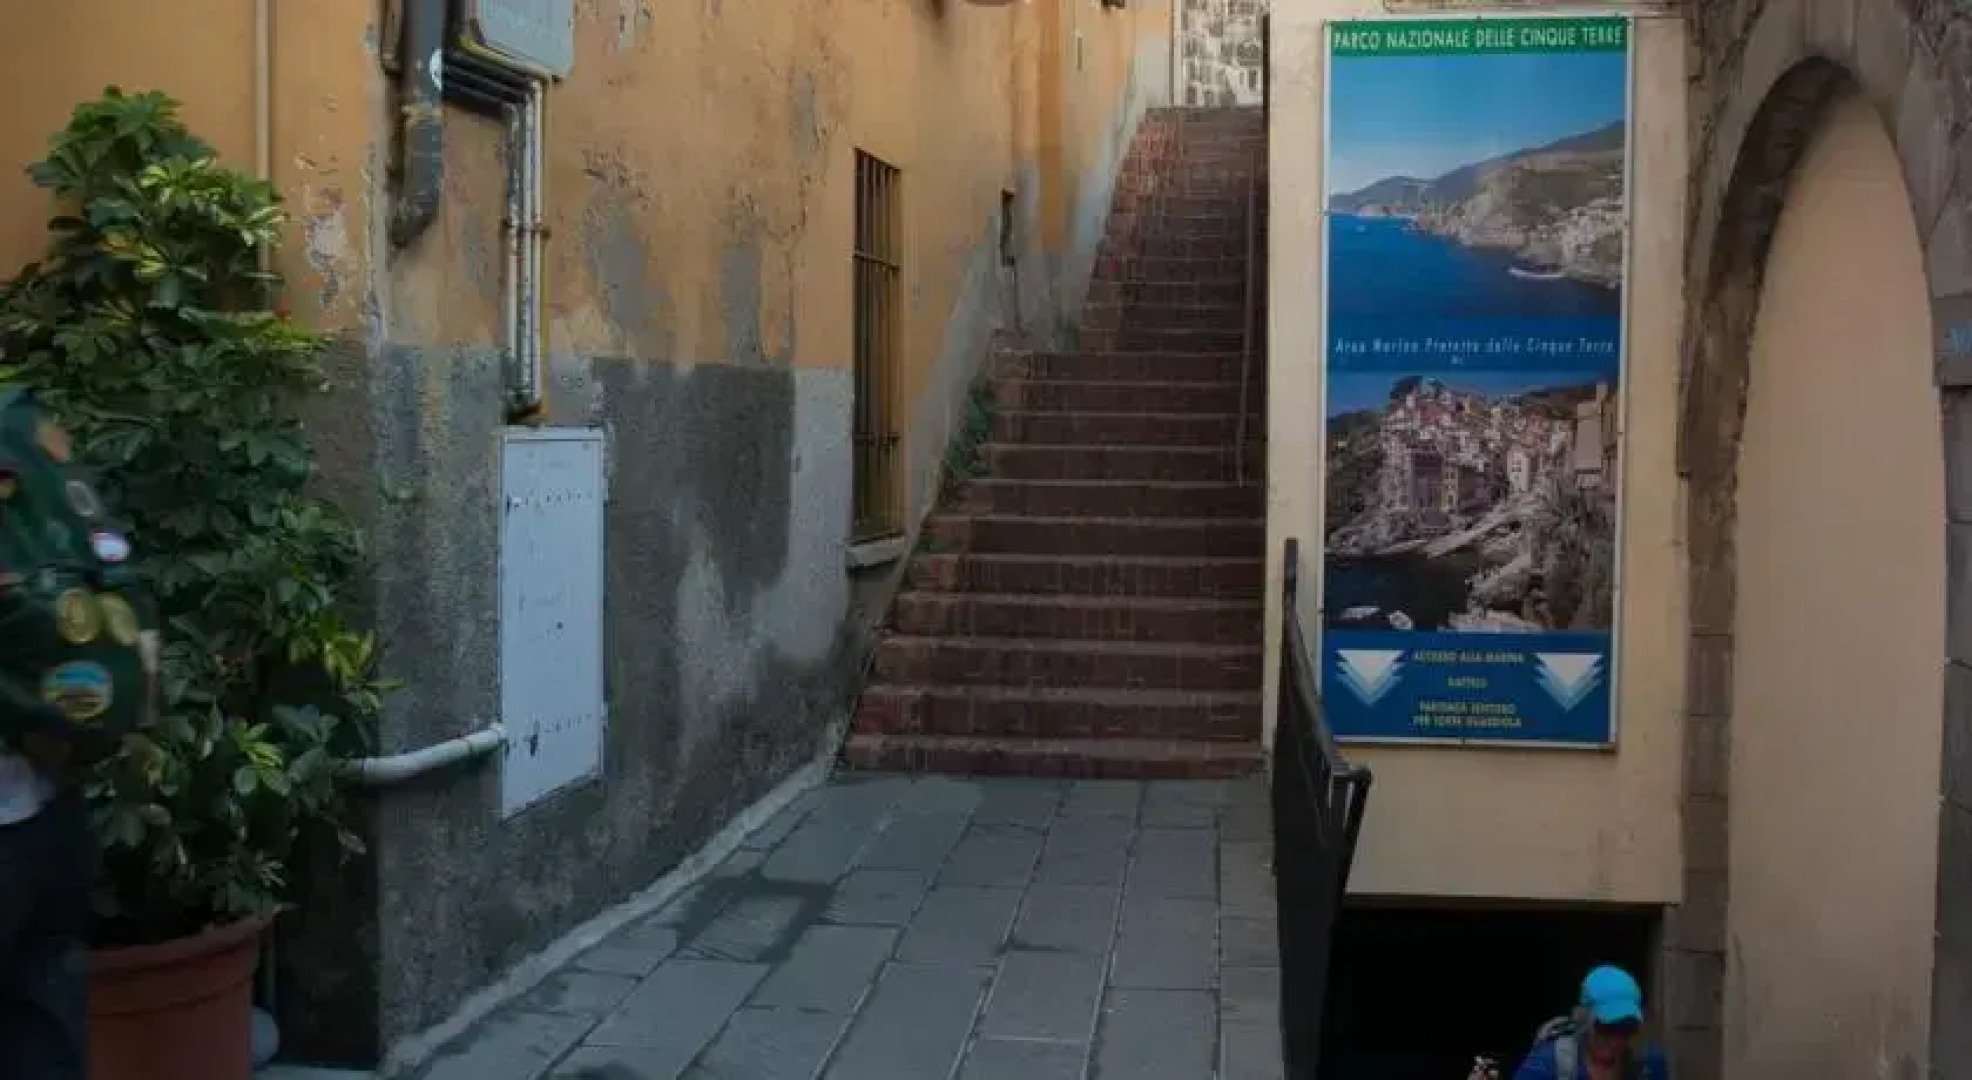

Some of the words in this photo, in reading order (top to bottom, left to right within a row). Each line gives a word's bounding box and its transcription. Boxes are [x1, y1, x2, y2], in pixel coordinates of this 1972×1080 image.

[1334, 30, 1379, 50] PARCO
[1386, 29, 1468, 48] NAZIONALE
[1476, 27, 1514, 47] DELLE
[1521, 27, 1576, 45] CINQUE
[1581, 25, 1623, 44] TERRE
[1335, 338, 1366, 352] Area
